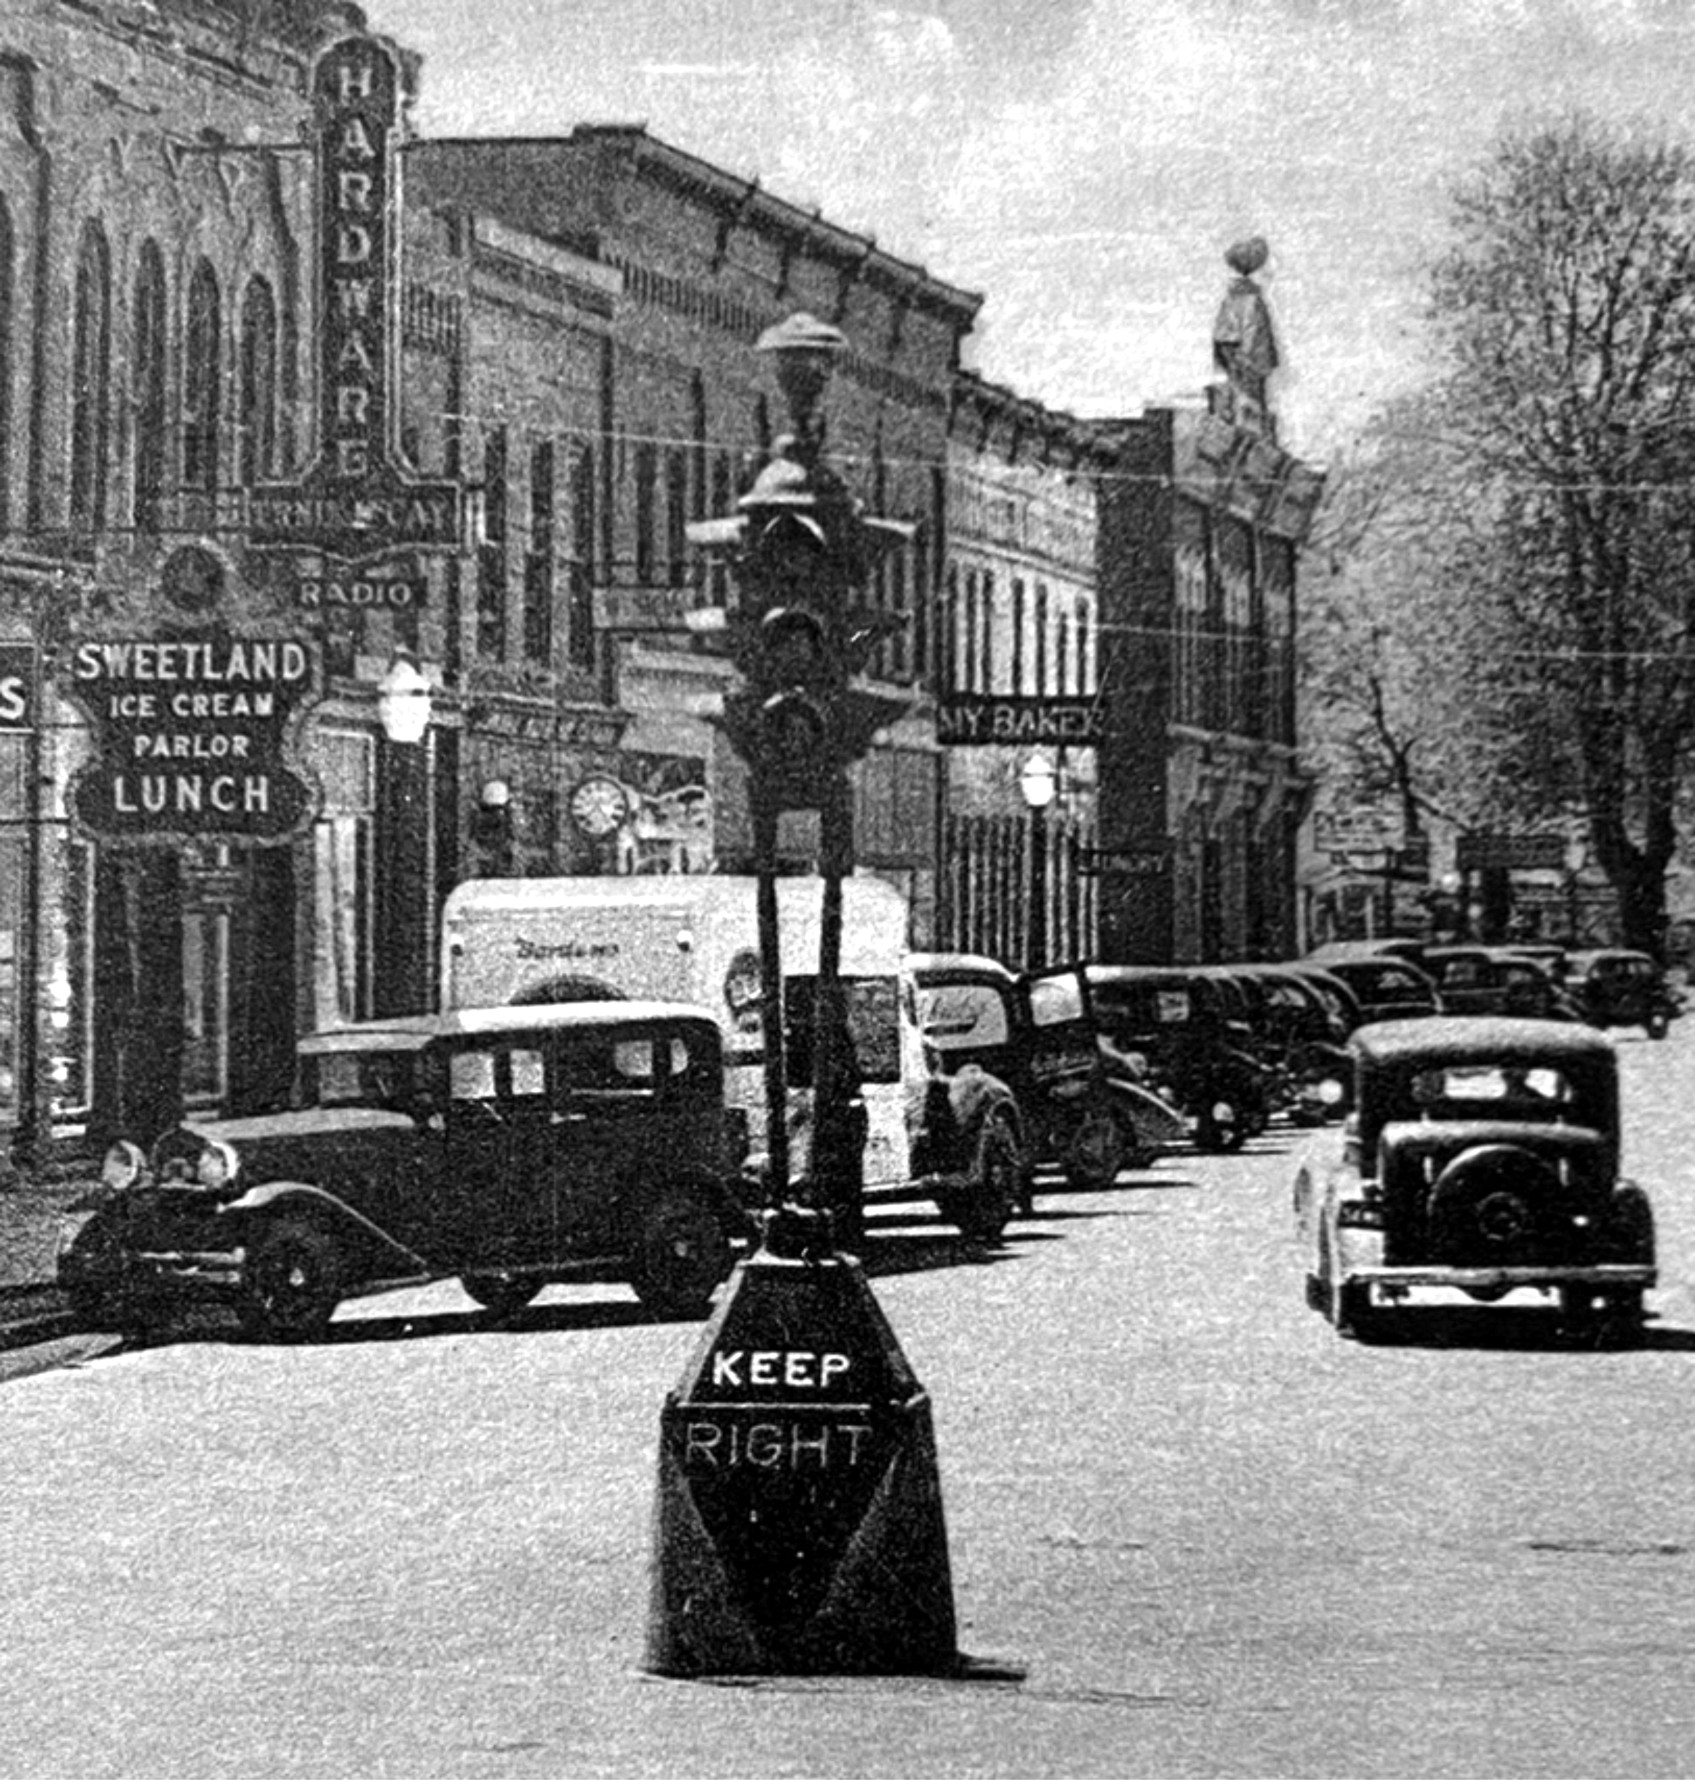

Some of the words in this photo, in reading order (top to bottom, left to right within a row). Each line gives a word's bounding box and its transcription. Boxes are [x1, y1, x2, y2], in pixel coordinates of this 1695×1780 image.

[335, 66, 375, 477] HARDWARE
[301, 582, 412, 605] RADIO
[77, 643, 306, 681] SWEETLAND
[110, 694, 157, 718] ICE
[172, 693, 274, 716] CREAM
[134, 734, 249, 758] PARLOR
[114, 775, 269, 812] LUNCH
[713, 1350, 850, 1388] KEEP
[686, 1422, 873, 1469] RIGHT
